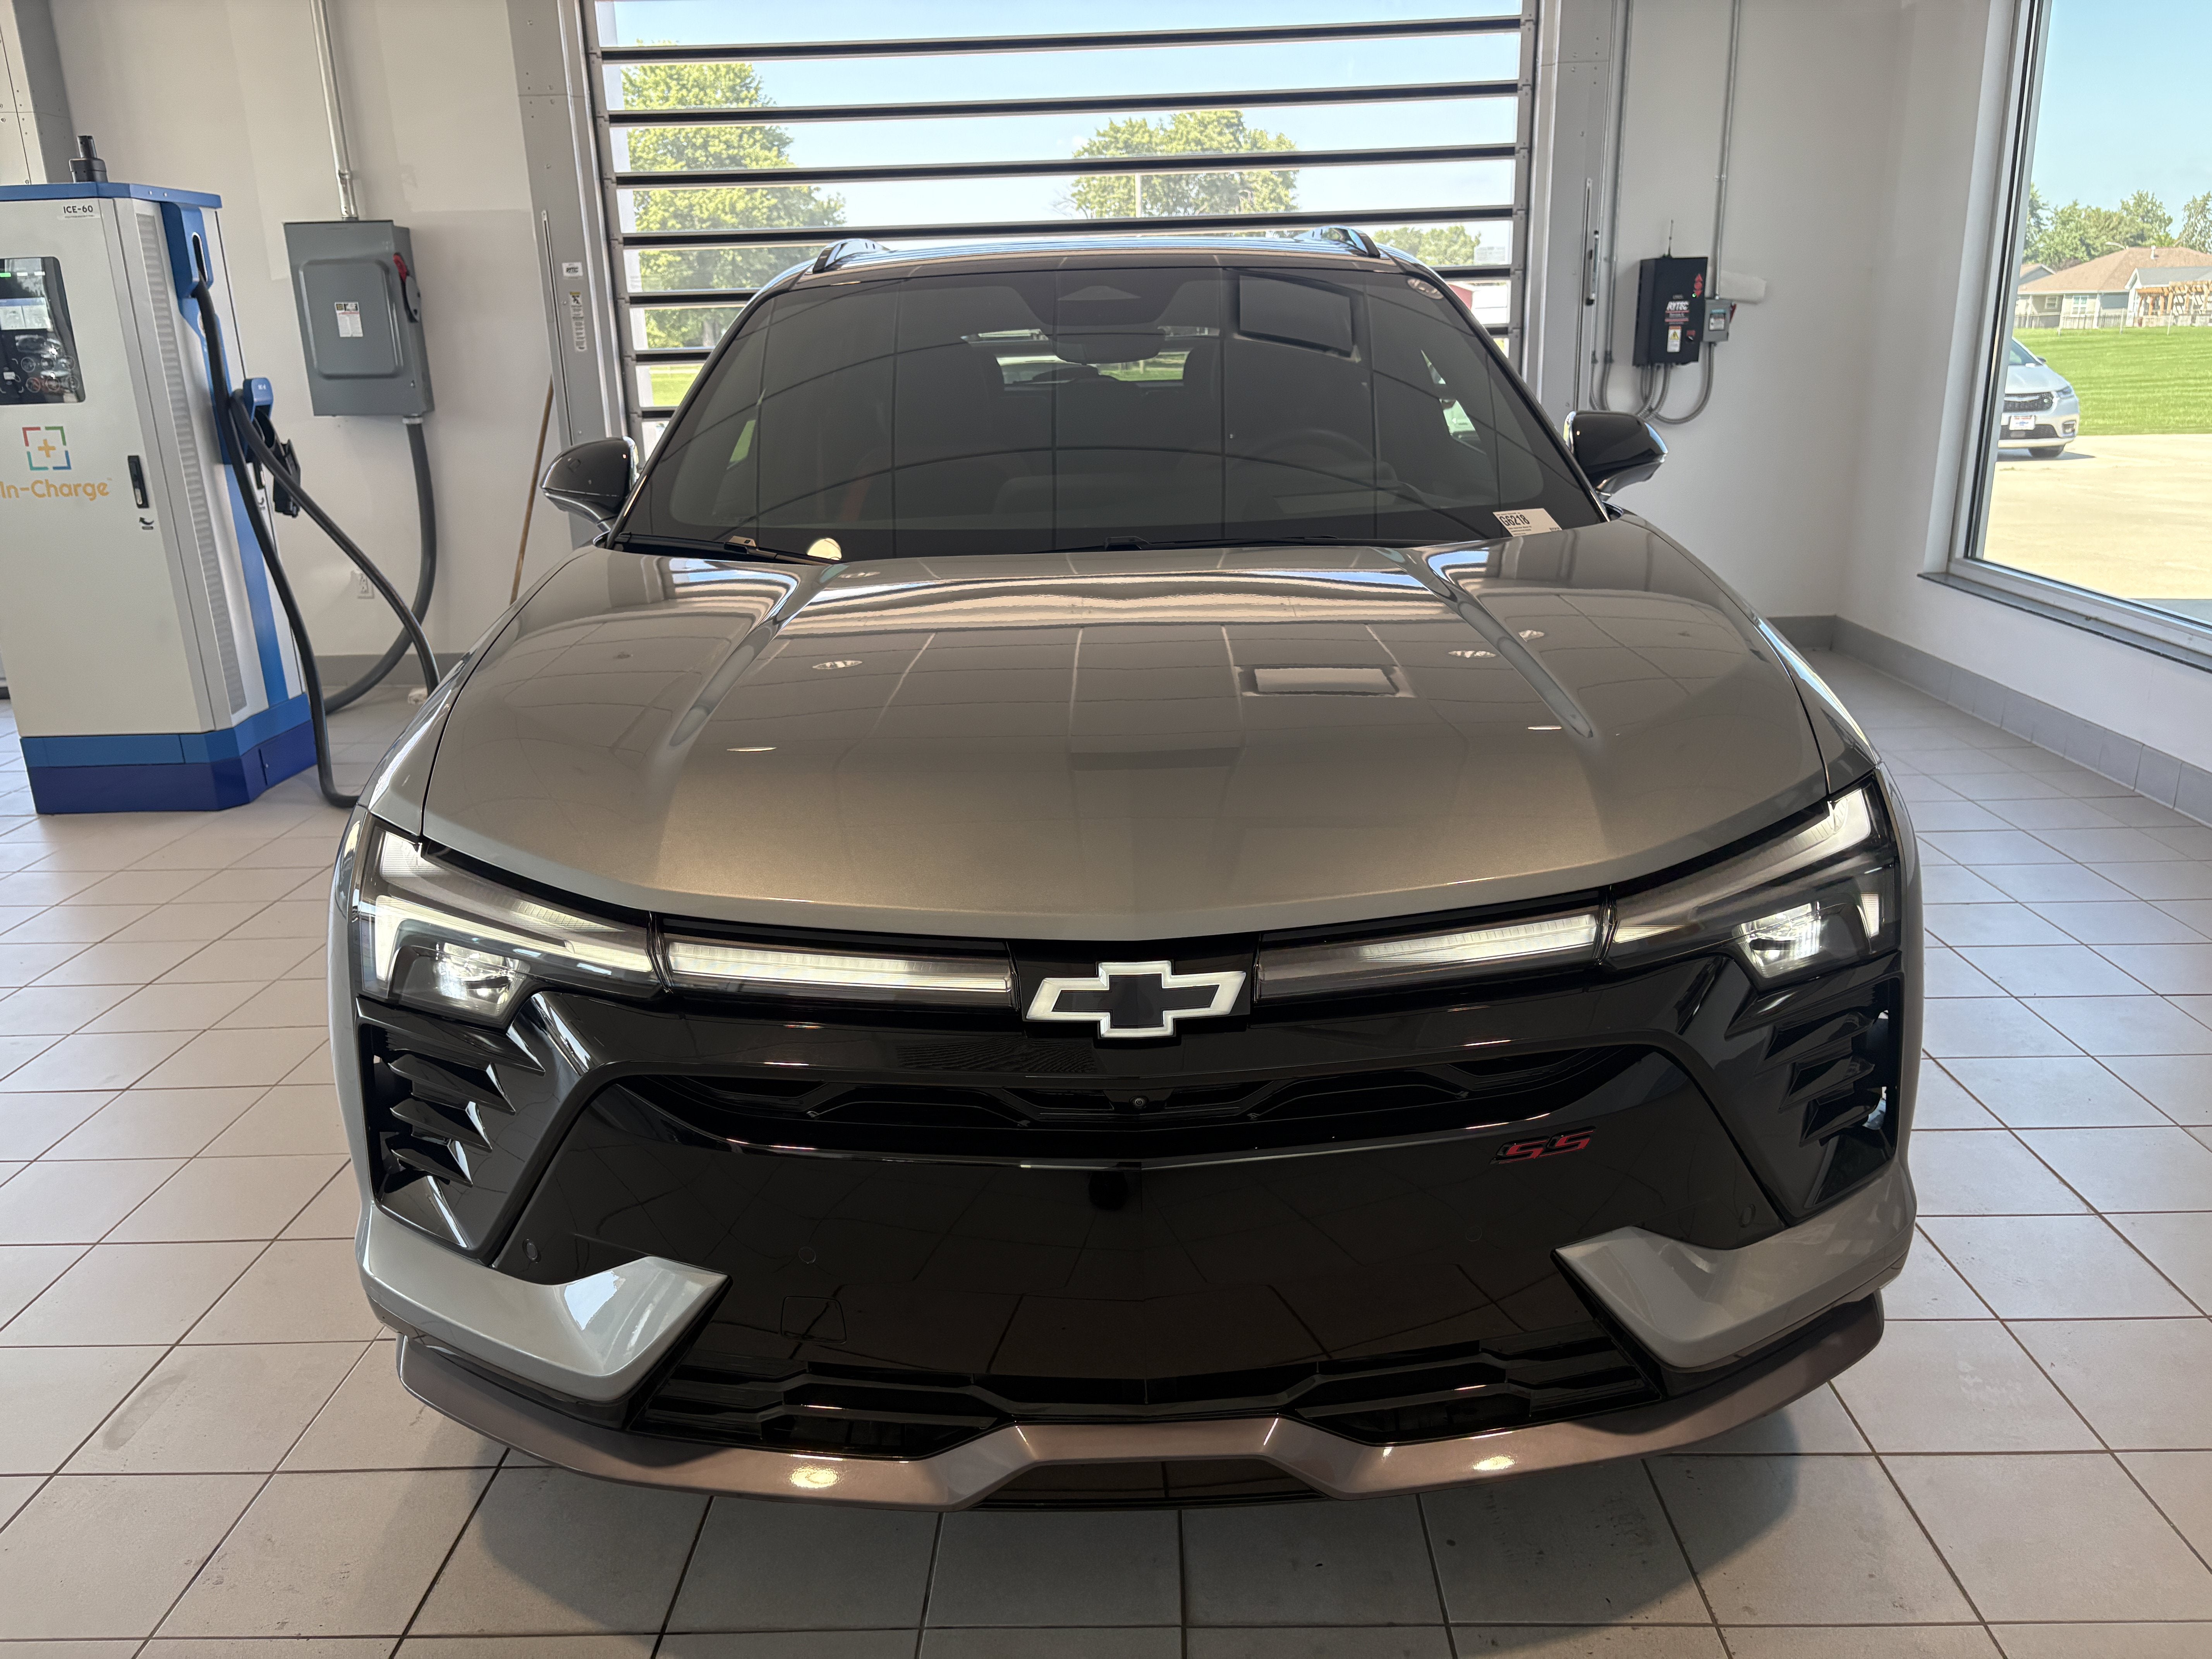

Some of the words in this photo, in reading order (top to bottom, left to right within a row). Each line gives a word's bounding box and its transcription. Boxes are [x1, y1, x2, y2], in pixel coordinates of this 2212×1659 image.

[63, 205, 93, 213] ICE-60
[0, 479, 110, 501] In-Charge
[1499, 514, 1530, 527] G6218
[1495, 1126, 1596, 1164] SS
